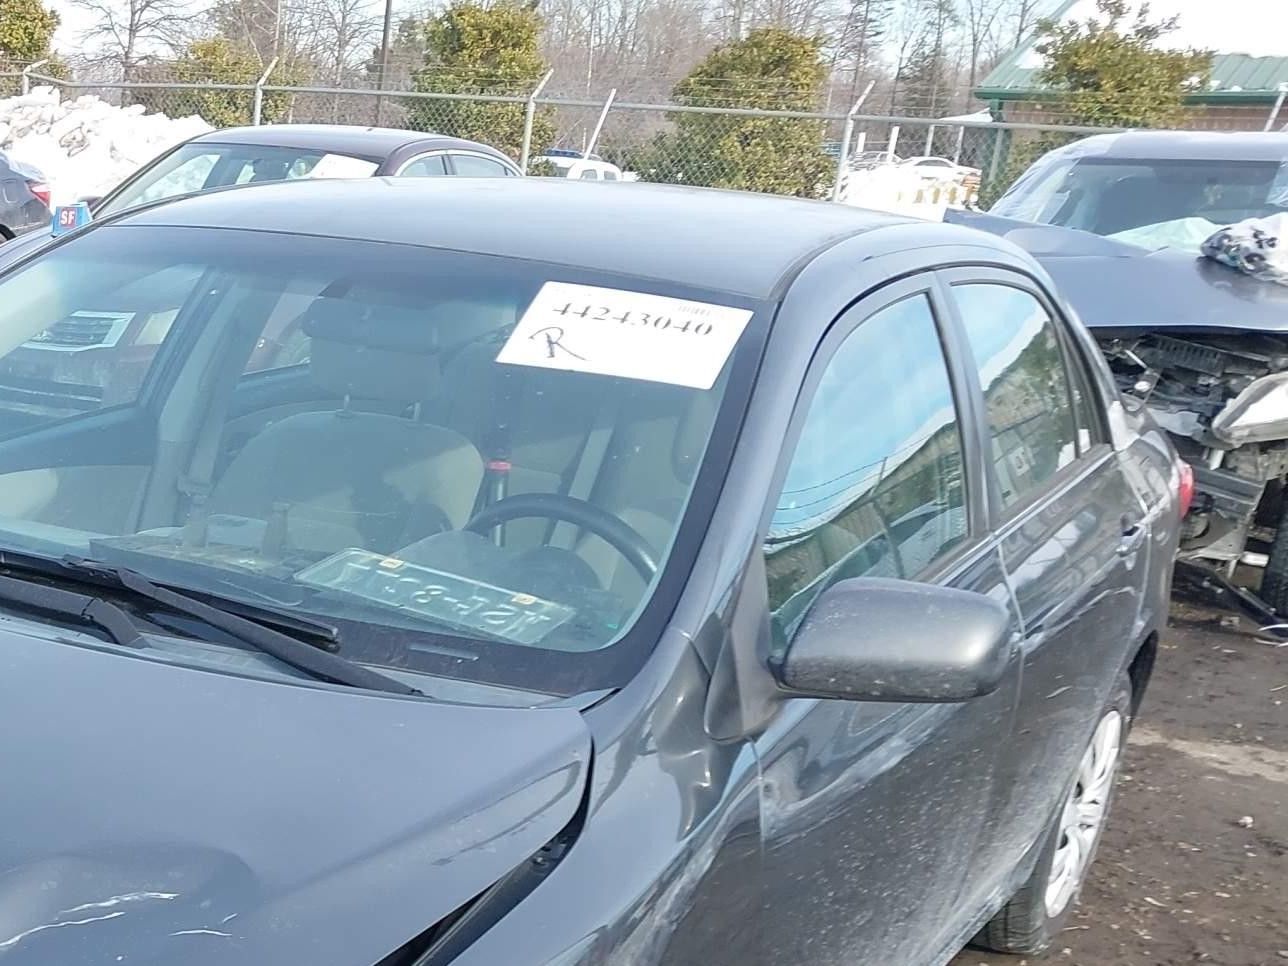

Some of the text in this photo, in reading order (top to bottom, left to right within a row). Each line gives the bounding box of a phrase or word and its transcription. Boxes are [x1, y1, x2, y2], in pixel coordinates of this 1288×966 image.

[60, 210, 76, 225] SF
[552, 302, 714, 336] 44243040
[528, 326, 588, 361] R
